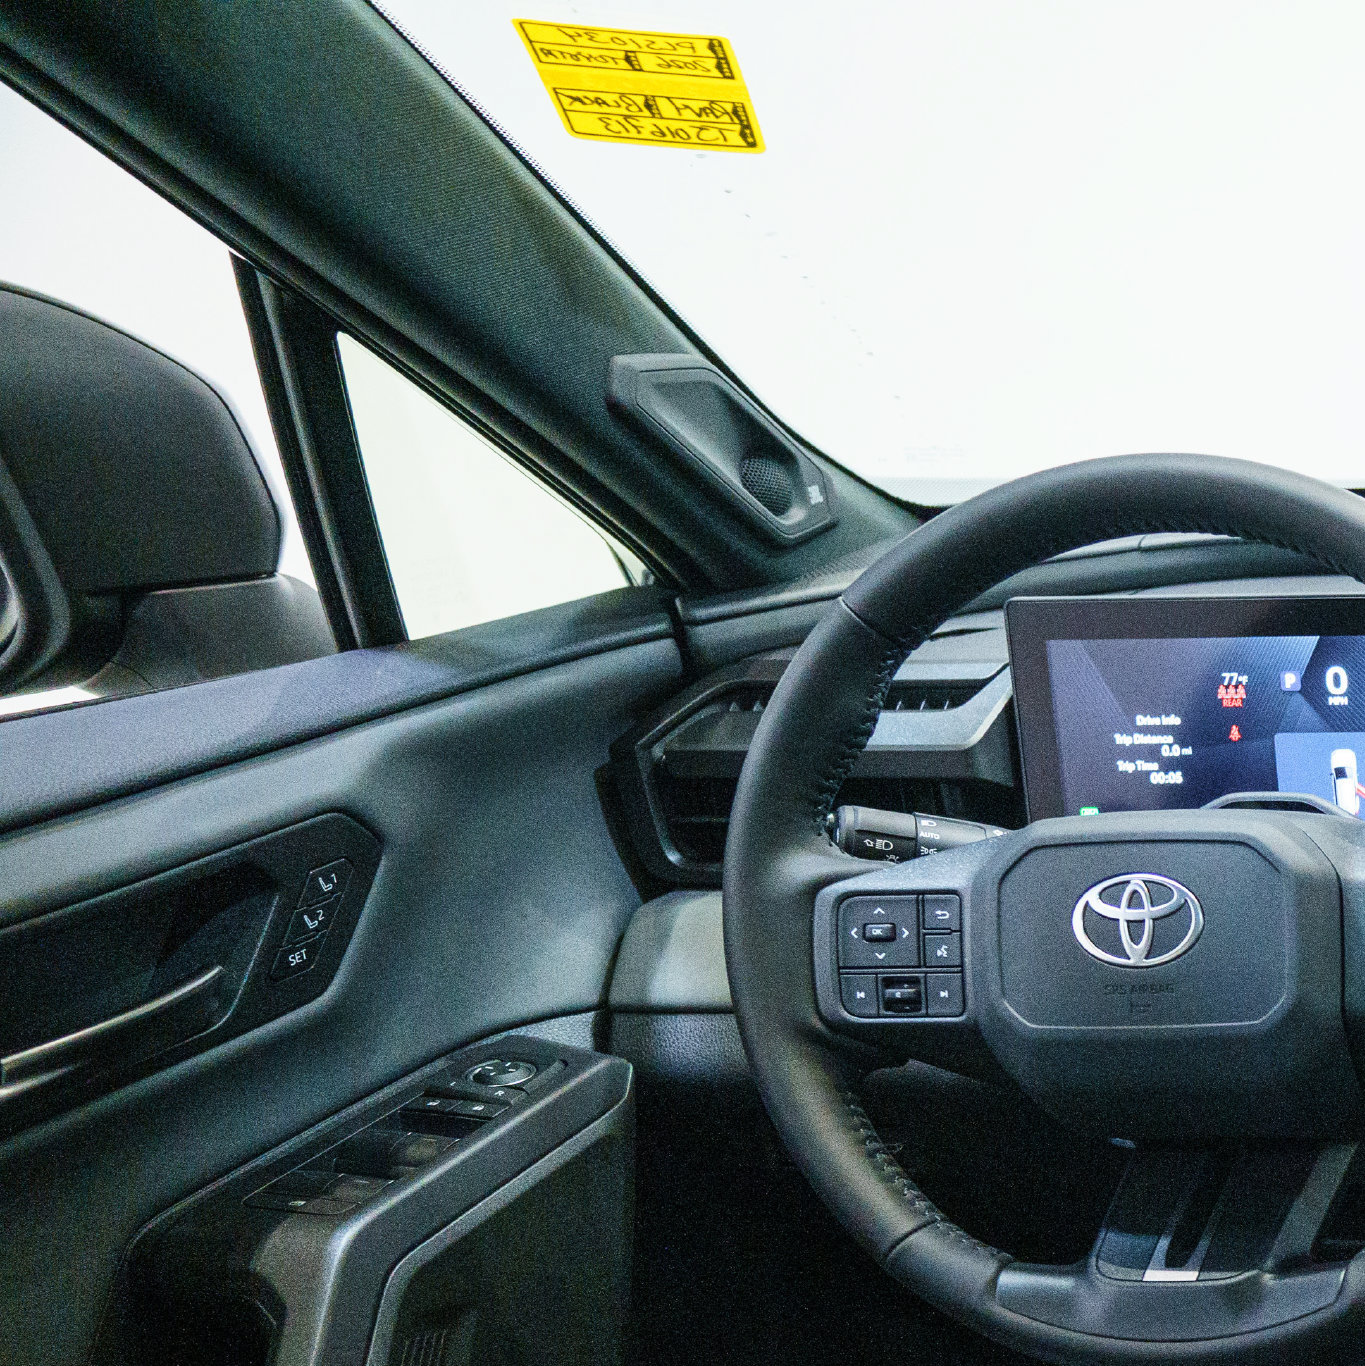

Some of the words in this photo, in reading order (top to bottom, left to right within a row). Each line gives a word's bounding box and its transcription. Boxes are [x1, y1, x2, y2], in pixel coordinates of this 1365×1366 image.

[1324, 665, 1350, 696] 0
[1135, 714, 1160, 726] Drive
[1161, 714, 1182, 726] Info
[1114, 733, 1133, 746] Trip
[1133, 733, 1174, 745] Distance
[1161, 744, 1181, 757] 0.0
[1116, 760, 1136, 773] Trip
[1136, 760, 1159, 772] Time
[1150, 771, 1184, 785] 00:05
[919, 831, 940, 840] AUTO
[288, 948, 308, 966] SET
